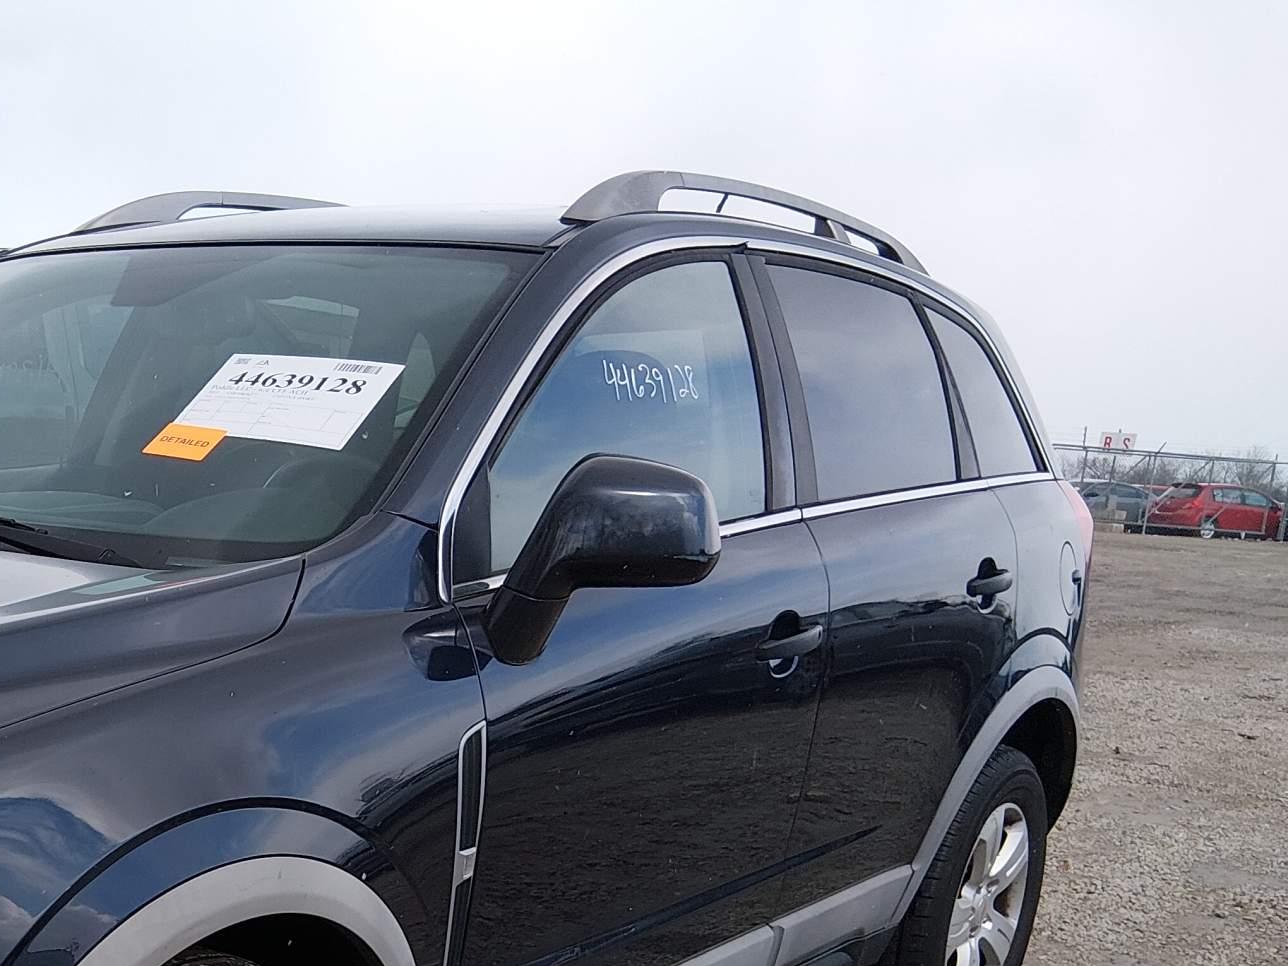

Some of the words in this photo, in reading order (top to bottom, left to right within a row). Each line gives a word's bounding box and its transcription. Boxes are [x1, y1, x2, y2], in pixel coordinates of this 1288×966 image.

[228, 371, 368, 395] 44639128
[602, 359, 699, 403] 44639128
[159, 435, 211, 448] DETAILED
